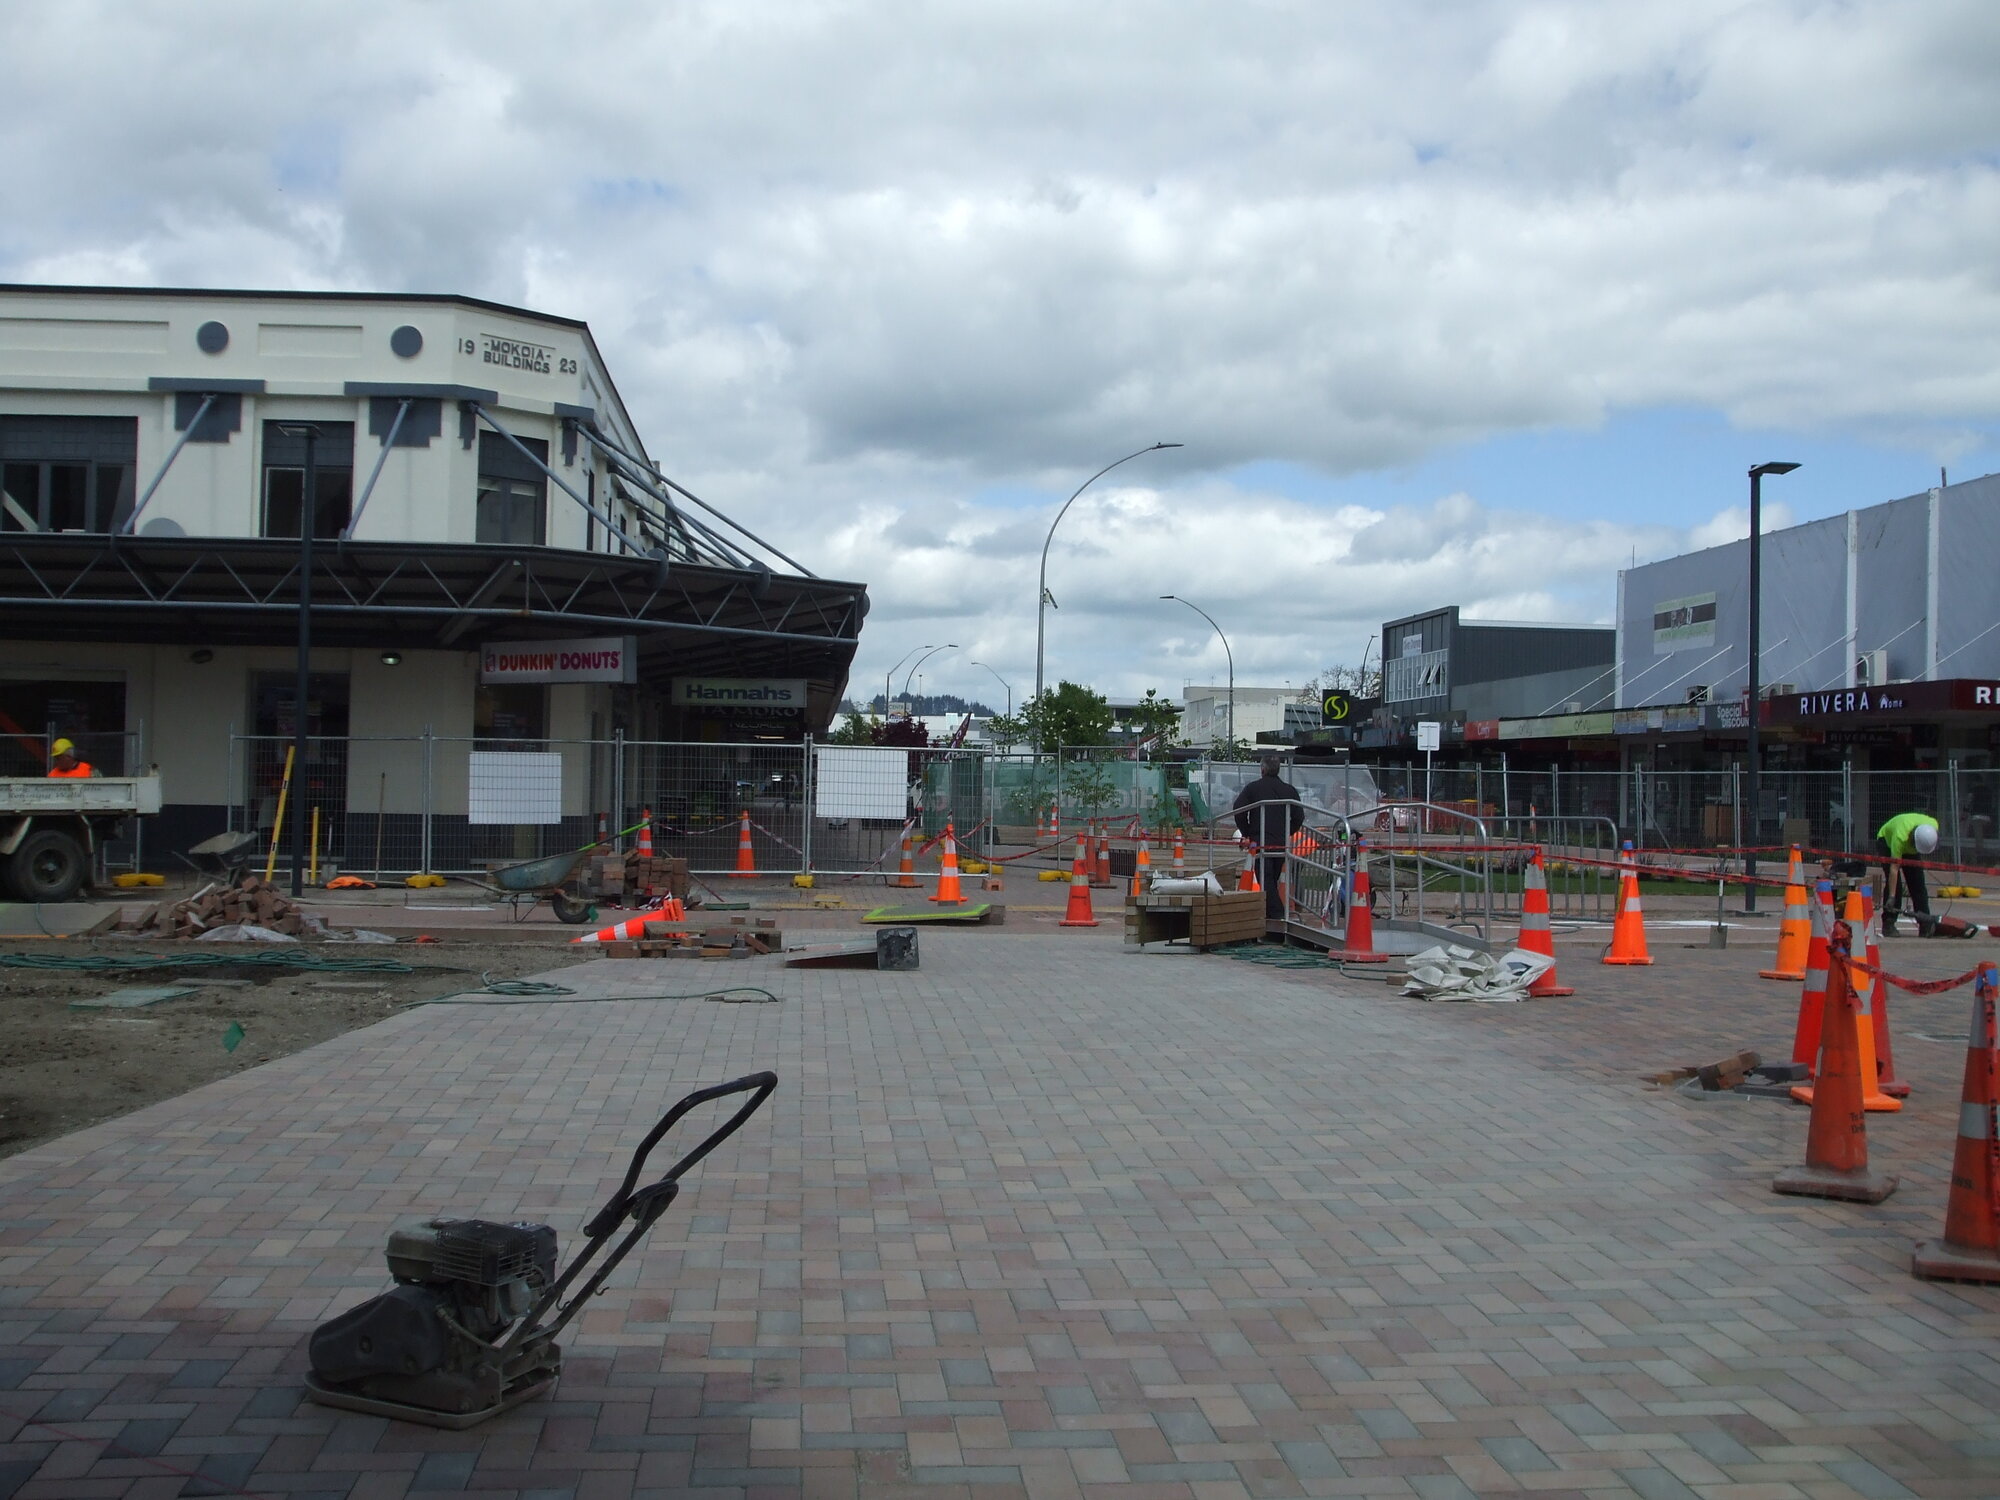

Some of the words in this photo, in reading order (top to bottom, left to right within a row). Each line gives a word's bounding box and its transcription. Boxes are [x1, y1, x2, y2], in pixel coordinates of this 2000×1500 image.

[457, 337, 476, 355] 19
[483, 350, 551, 374] BUILDINGS
[559, 357, 577, 375] 23
[498, 652, 558, 672] DUNKIN'
[559, 650, 620, 671] DONUTS
[686, 683, 792, 701] Hannahs
[1717, 704, 1743, 718] Special
[1800, 690, 1870, 716] RIVERA
[1721, 715, 1750, 729] DISCOUN
